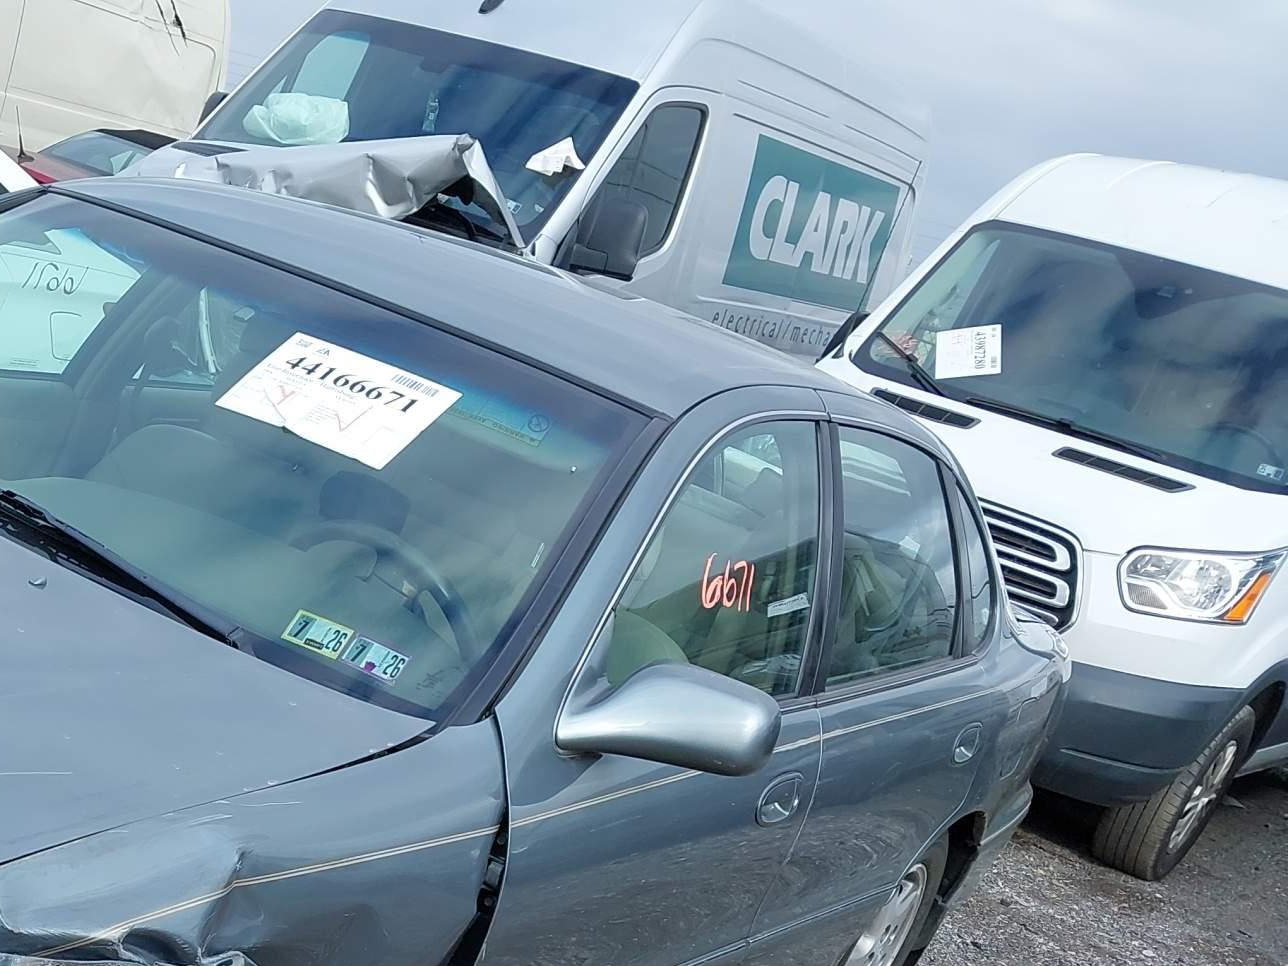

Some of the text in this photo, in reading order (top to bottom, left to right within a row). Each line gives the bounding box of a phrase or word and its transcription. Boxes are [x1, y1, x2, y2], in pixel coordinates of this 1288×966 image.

[749, 174, 886, 285] CLARK
[285, 355, 419, 414] 44166671
[701, 551, 755, 612] 6671
[293, 619, 309, 638] 7
[325, 629, 348, 653] 26
[351, 643, 367, 662] 7
[382, 654, 406, 679] 26
